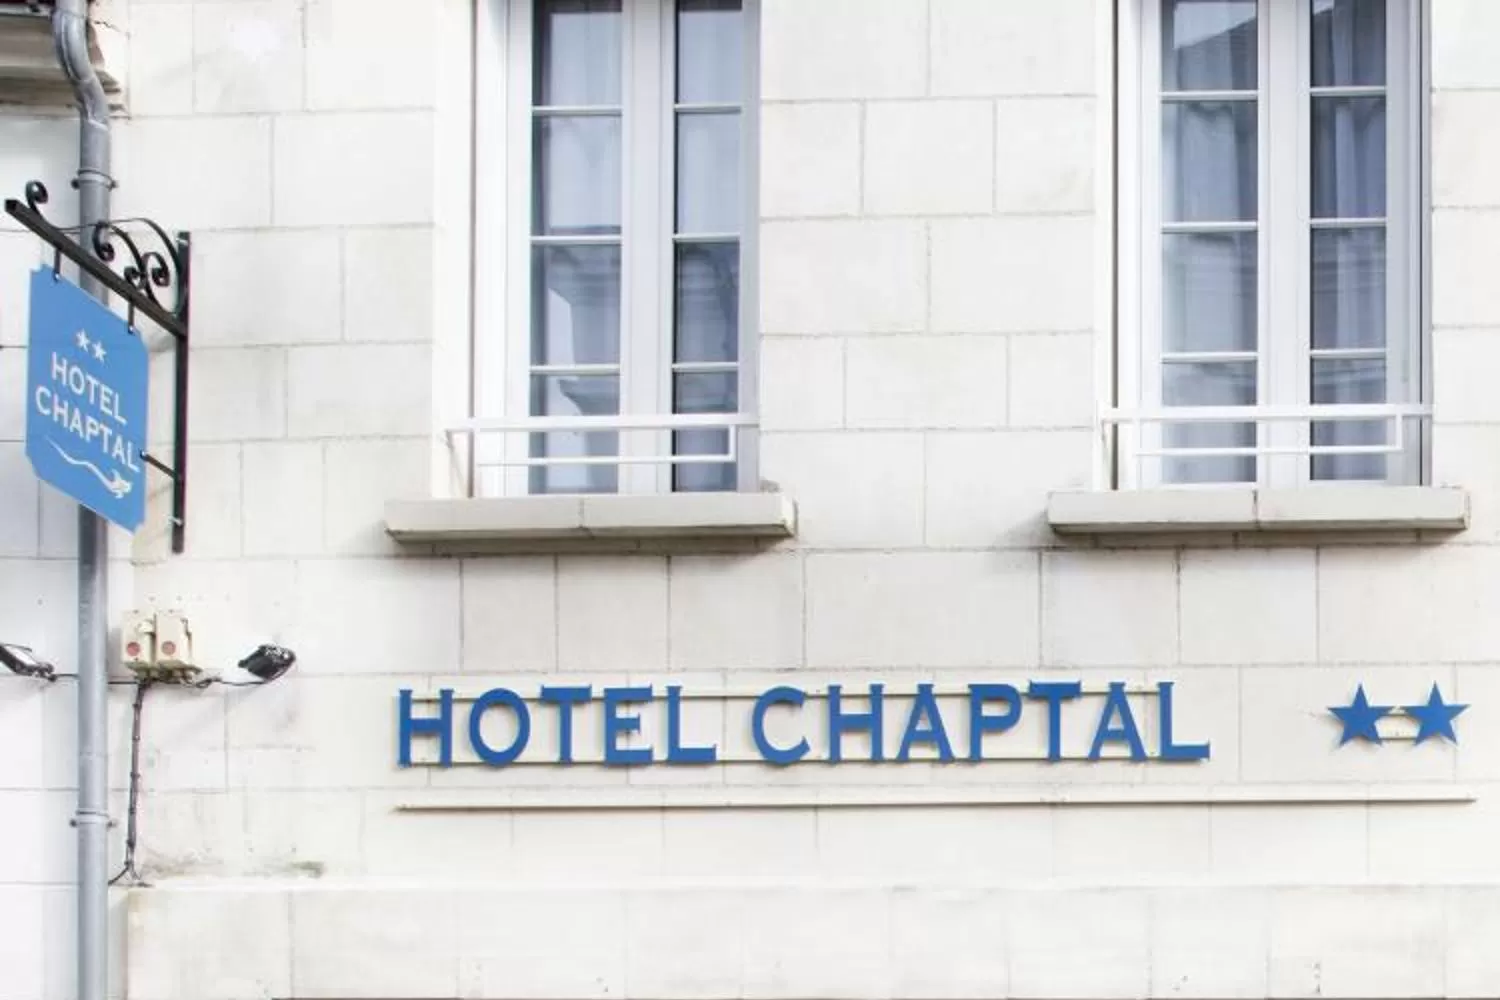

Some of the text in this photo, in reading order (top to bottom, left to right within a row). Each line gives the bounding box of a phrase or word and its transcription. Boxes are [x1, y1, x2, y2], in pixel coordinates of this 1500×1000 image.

[35, 385, 141, 473] CHAPTAL
[51, 351, 128, 426] HOTEL
[398, 681, 1211, 767] HOTEL CHAPTAL
